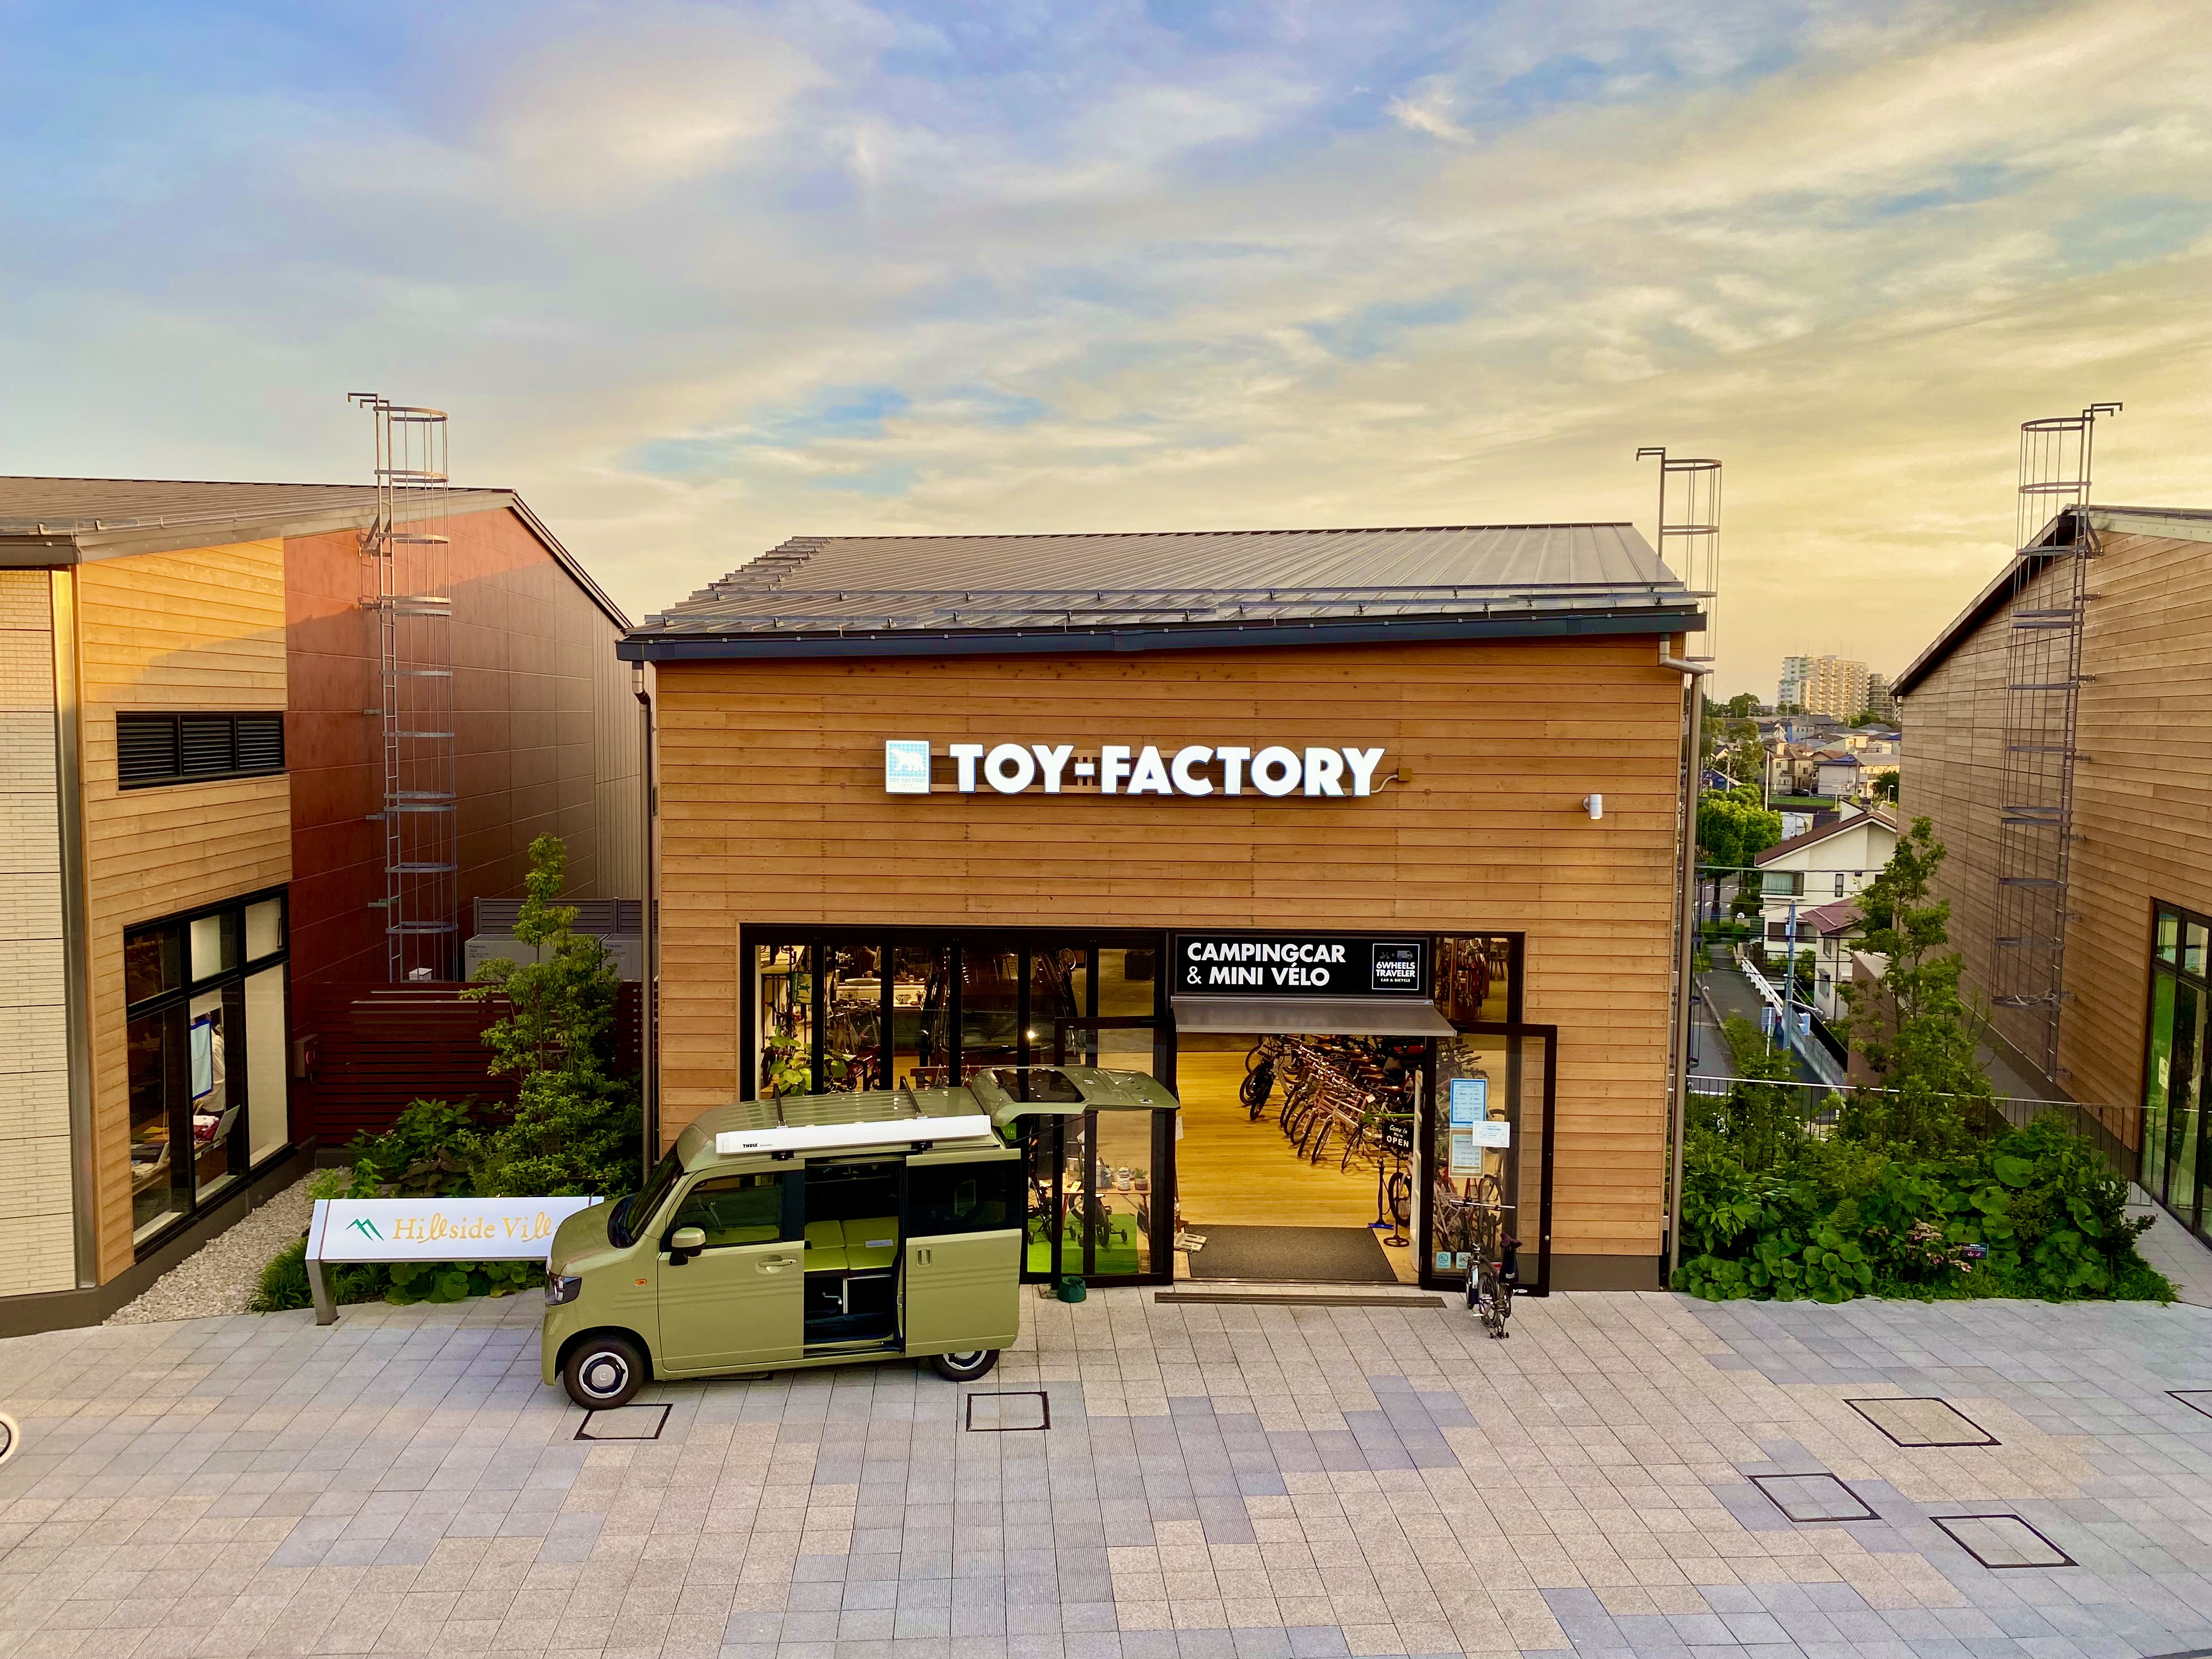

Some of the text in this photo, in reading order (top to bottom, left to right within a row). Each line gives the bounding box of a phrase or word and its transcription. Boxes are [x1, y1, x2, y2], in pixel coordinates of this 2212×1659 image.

[949, 743, 1386, 797] TOY-FACTORY
[1187, 943, 1346, 963] CAMPINGCAR
[1187, 963, 1330, 986] & MINI VÉLO
[1389, 1124, 1402, 1133] Come
[1386, 1135, 1409, 1148] OPEN
[392, 1211, 558, 1243] Hillside Vill
